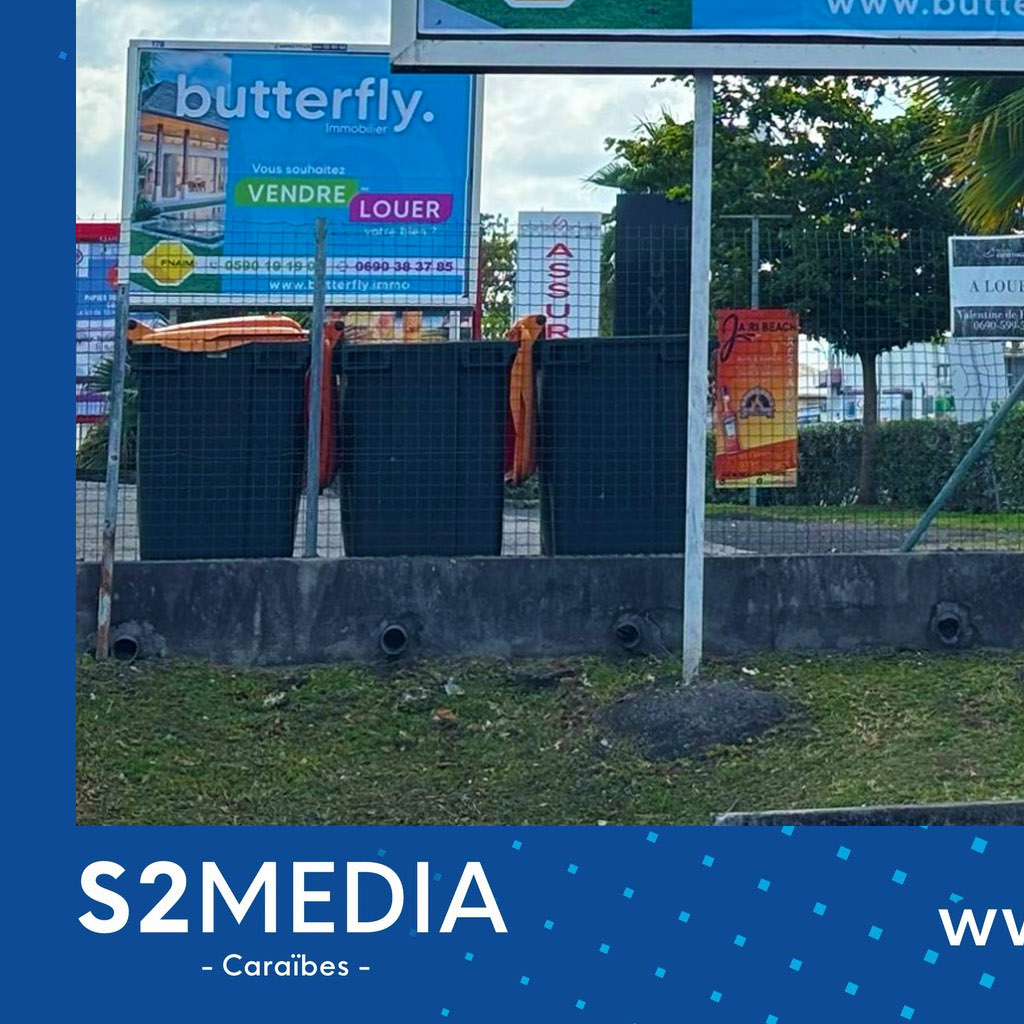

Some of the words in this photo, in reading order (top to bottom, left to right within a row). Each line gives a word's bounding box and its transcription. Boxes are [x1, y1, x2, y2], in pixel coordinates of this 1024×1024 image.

[175, 73, 435, 133] butterfly.
[325, 122, 389, 135] Immobilier
[252, 162, 283, 174] Vous
[285, 163, 346, 176] souhaitez
[247, 183, 347, 204] VENDRE
[359, 199, 441, 219] LOUER
[160, 258, 195, 267] FNAIM
[355, 260, 390, 272] 0690
[394, 260, 411, 272] 38
[415, 260, 433, 272] 37
[436, 260, 454, 272] 85
[269, 278, 411, 292] www.btterfly.immo
